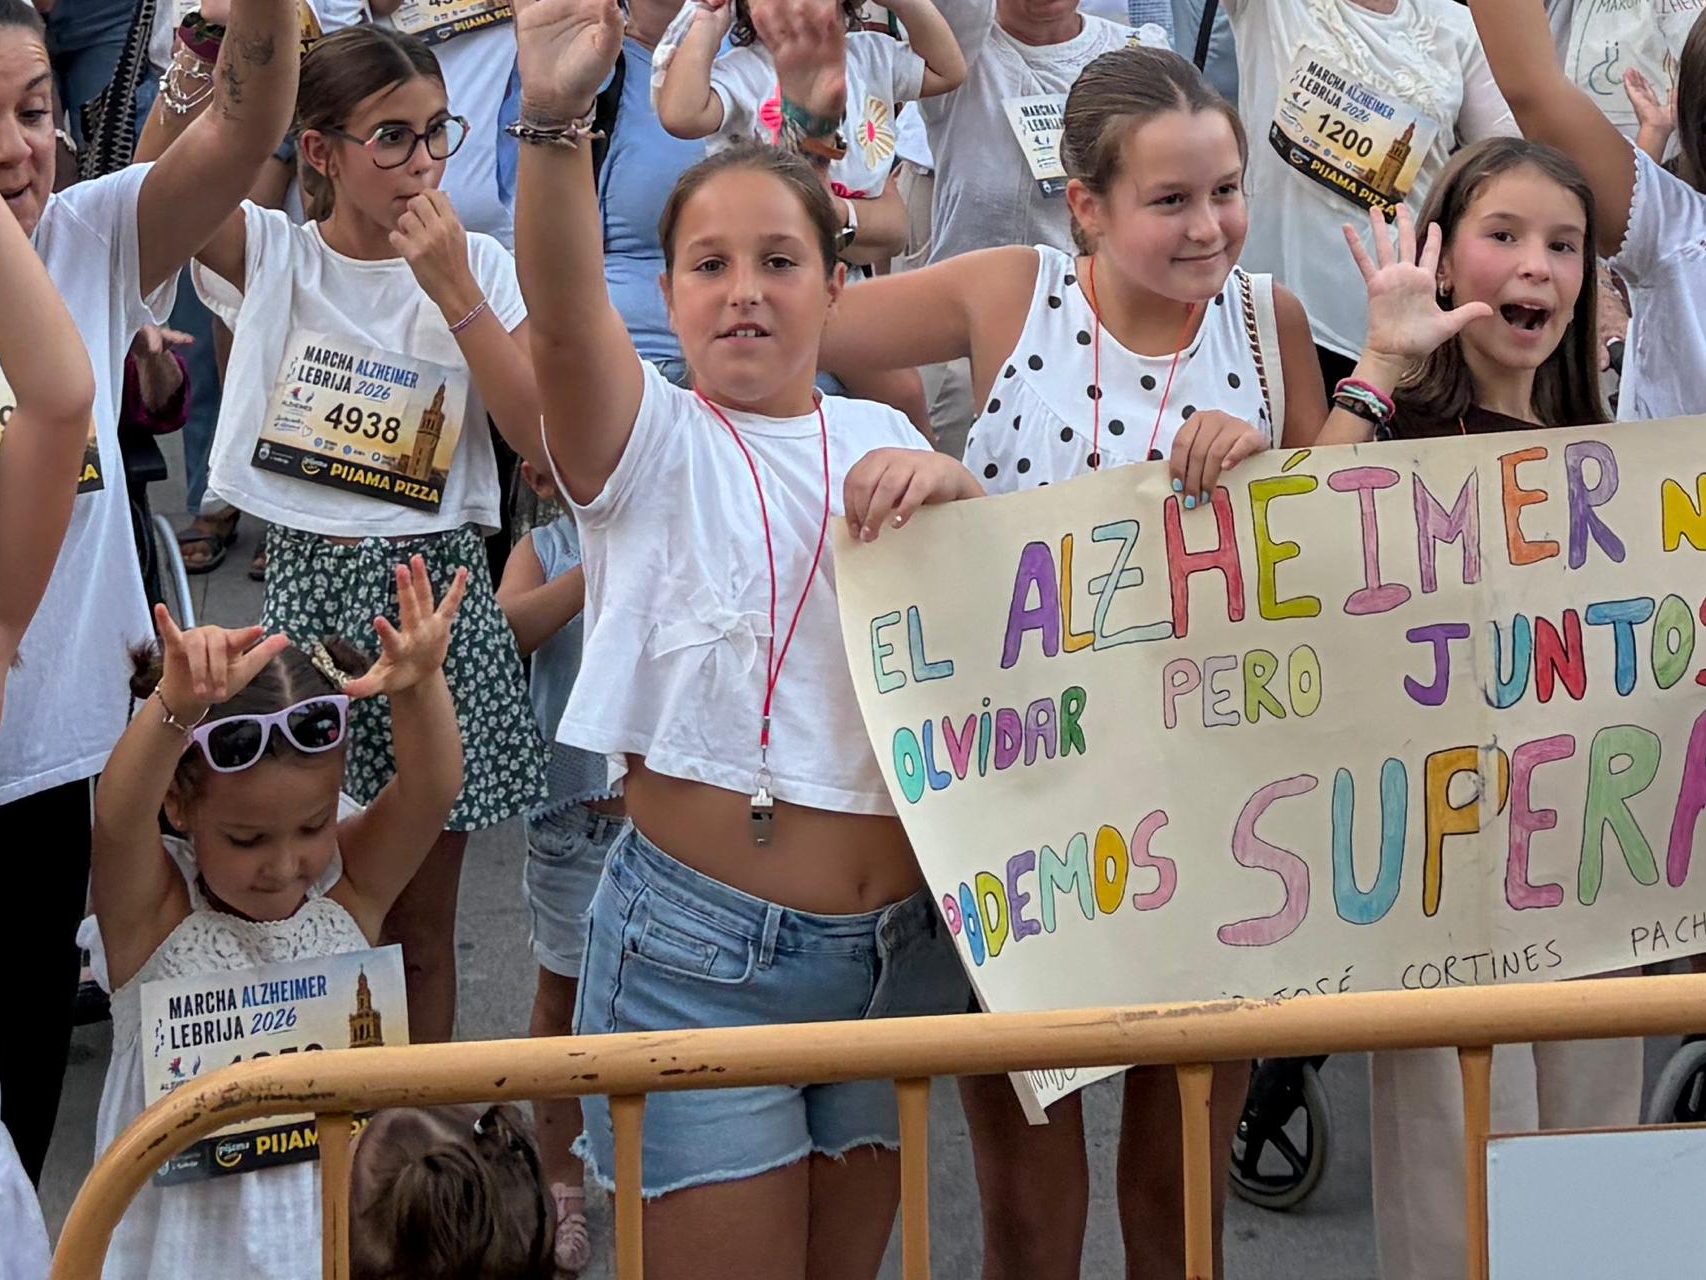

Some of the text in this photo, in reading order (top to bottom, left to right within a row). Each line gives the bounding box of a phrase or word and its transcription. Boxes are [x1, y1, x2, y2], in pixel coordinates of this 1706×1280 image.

[453, 12, 492, 32] PIJAMA
[1299, 72, 1370, 124] LEBRIJA 2026
[1306, 60, 1396, 121] MARCHA ALZHEIMER
[1317, 111, 1374, 158] 1200
[1310, 158, 1396, 216] PIJAMA PIZZA
[297, 365, 392, 401] LEBRIJA 2026
[302, 345, 420, 389] MARCHA ALZHEIMER
[323, 402, 402, 445] 4938
[329, 462, 440, 504] PIJAMA PIZZA
[870, 604, 955, 695] EL
[1160, 640, 1324, 733] PERO
[1401, 938, 1563, 991] CORTINES
[168, 974, 328, 1020] MARCHA ALZHEIMER
[169, 1010, 298, 1051] LEBRIJA 2026
